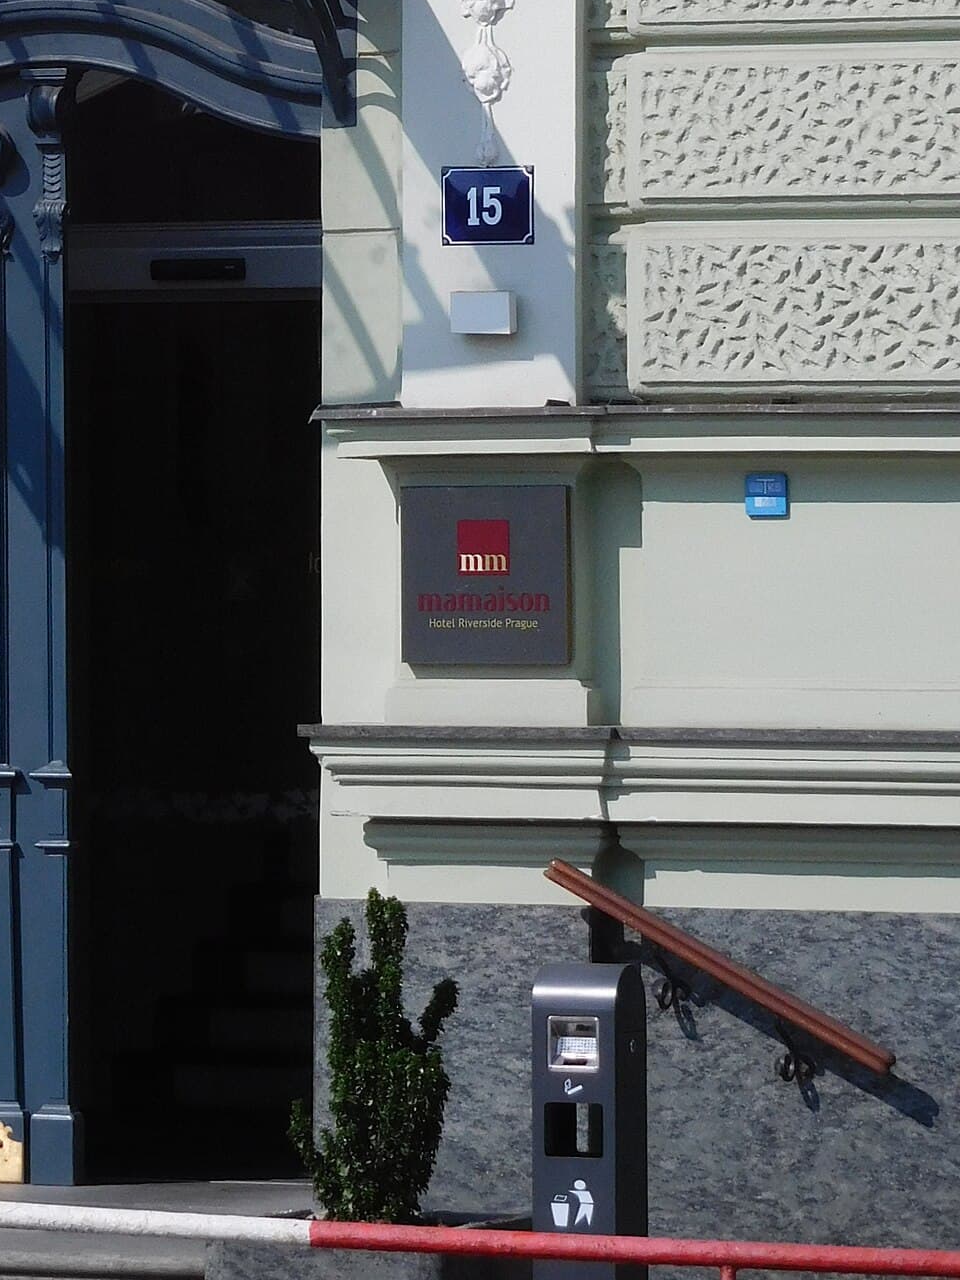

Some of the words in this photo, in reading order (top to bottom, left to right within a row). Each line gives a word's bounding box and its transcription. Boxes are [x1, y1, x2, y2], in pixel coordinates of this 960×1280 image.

[467, 186, 502, 226] 15
[460, 553, 507, 572] mm
[417, 586, 551, 612] mamaison
[429, 618, 455, 628] Hotel
[458, 618, 502, 628] Riverside
[505, 618, 538, 630] Prague
